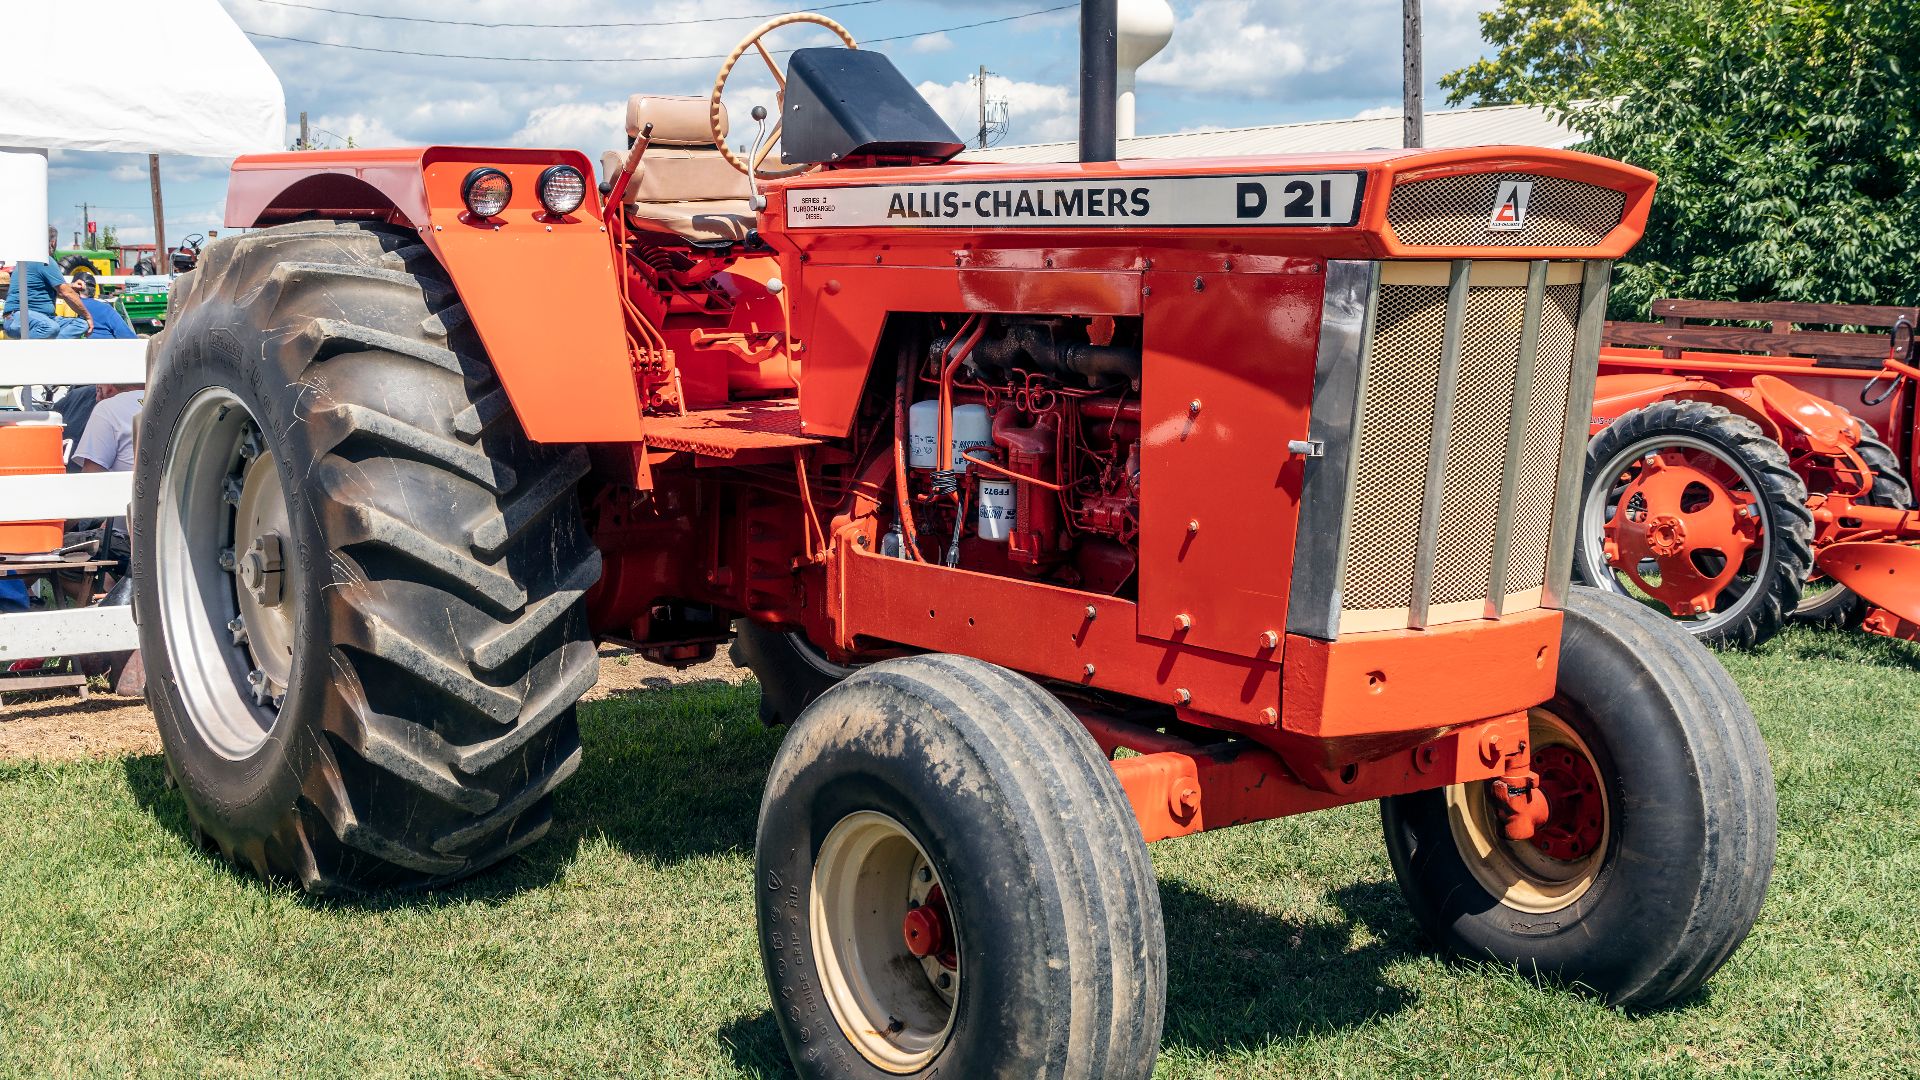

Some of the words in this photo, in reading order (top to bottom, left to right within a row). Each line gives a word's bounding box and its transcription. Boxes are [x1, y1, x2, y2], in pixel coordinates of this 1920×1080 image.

[887, 188, 1150, 218] ALLIS-CHALMERS
[1237, 183, 1267, 218] D
[1284, 180, 1331, 218] 21
[789, 886, 799, 908] RIB
[792, 932, 804, 966] GRIP
[800, 972, 817, 1013] GUIDE
